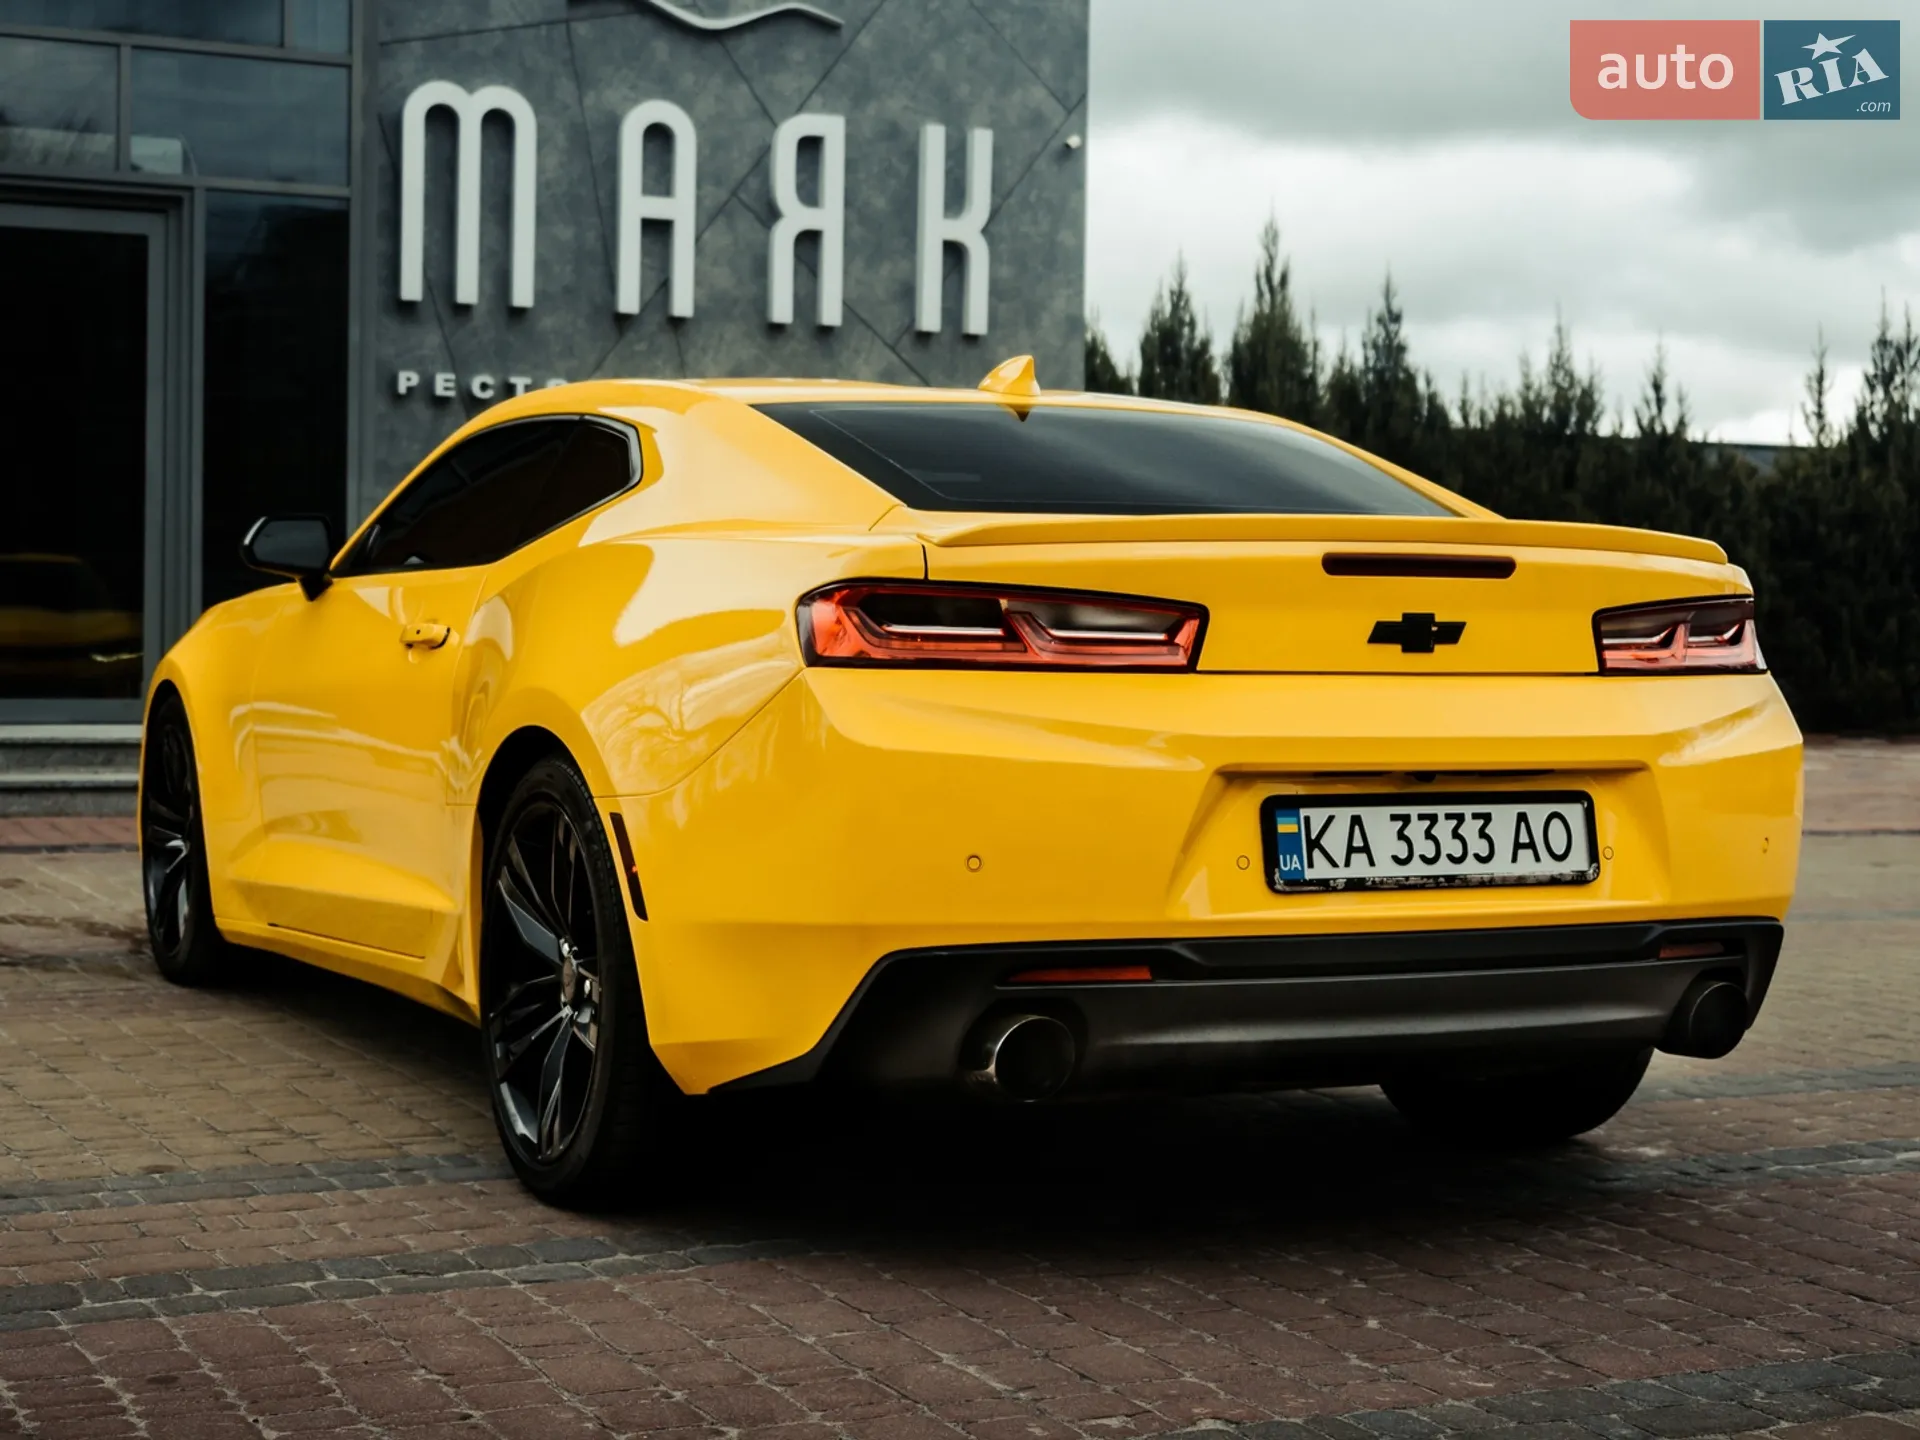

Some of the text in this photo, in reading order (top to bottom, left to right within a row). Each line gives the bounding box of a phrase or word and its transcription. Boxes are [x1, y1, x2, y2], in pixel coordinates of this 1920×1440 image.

[399, 80, 994, 336] МАЯК
[1280, 854, 1302, 870] UA
[1303, 810, 1573, 869] KA 3333 AO
